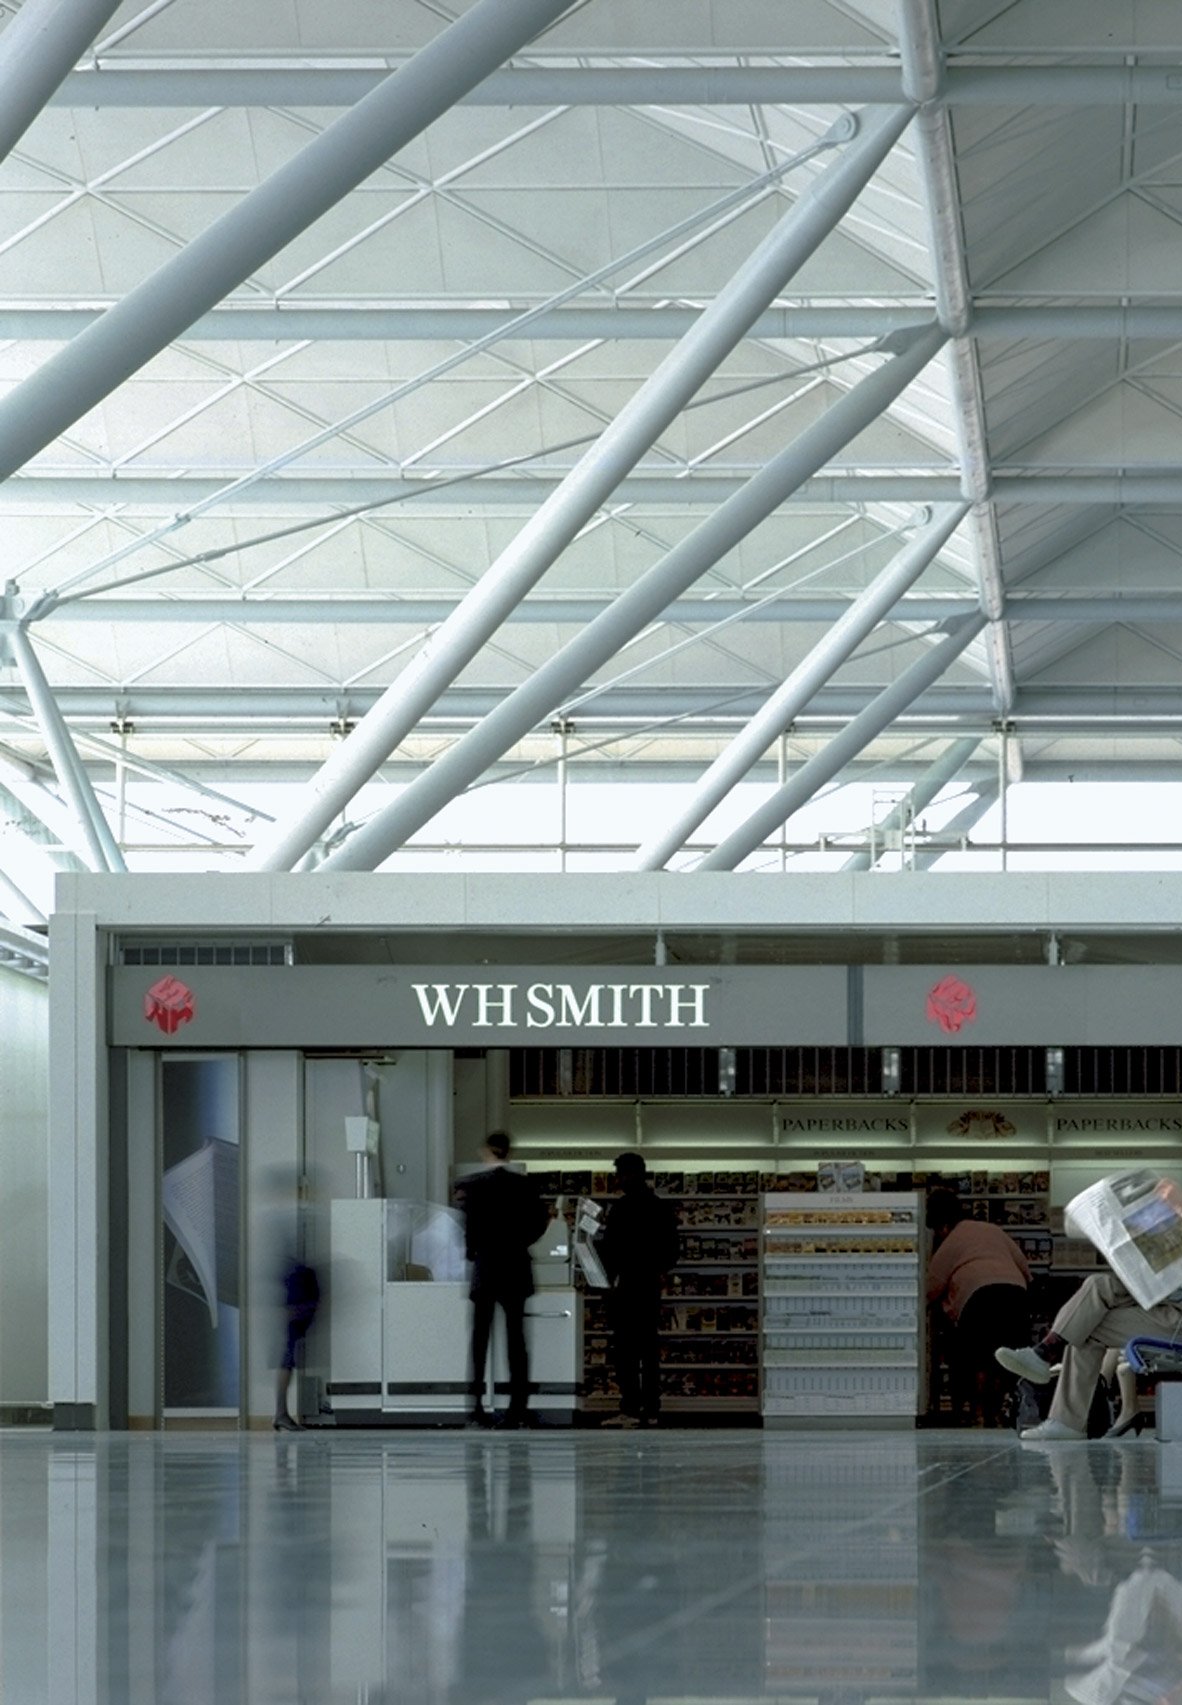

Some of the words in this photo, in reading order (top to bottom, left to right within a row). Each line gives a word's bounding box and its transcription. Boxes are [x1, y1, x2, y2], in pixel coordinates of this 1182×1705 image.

[526, 983, 710, 1028] SMITH
[782, 1117, 909, 1132] PAPERBACKS
[1056, 1117, 1182, 1132] PAPERBACKS
